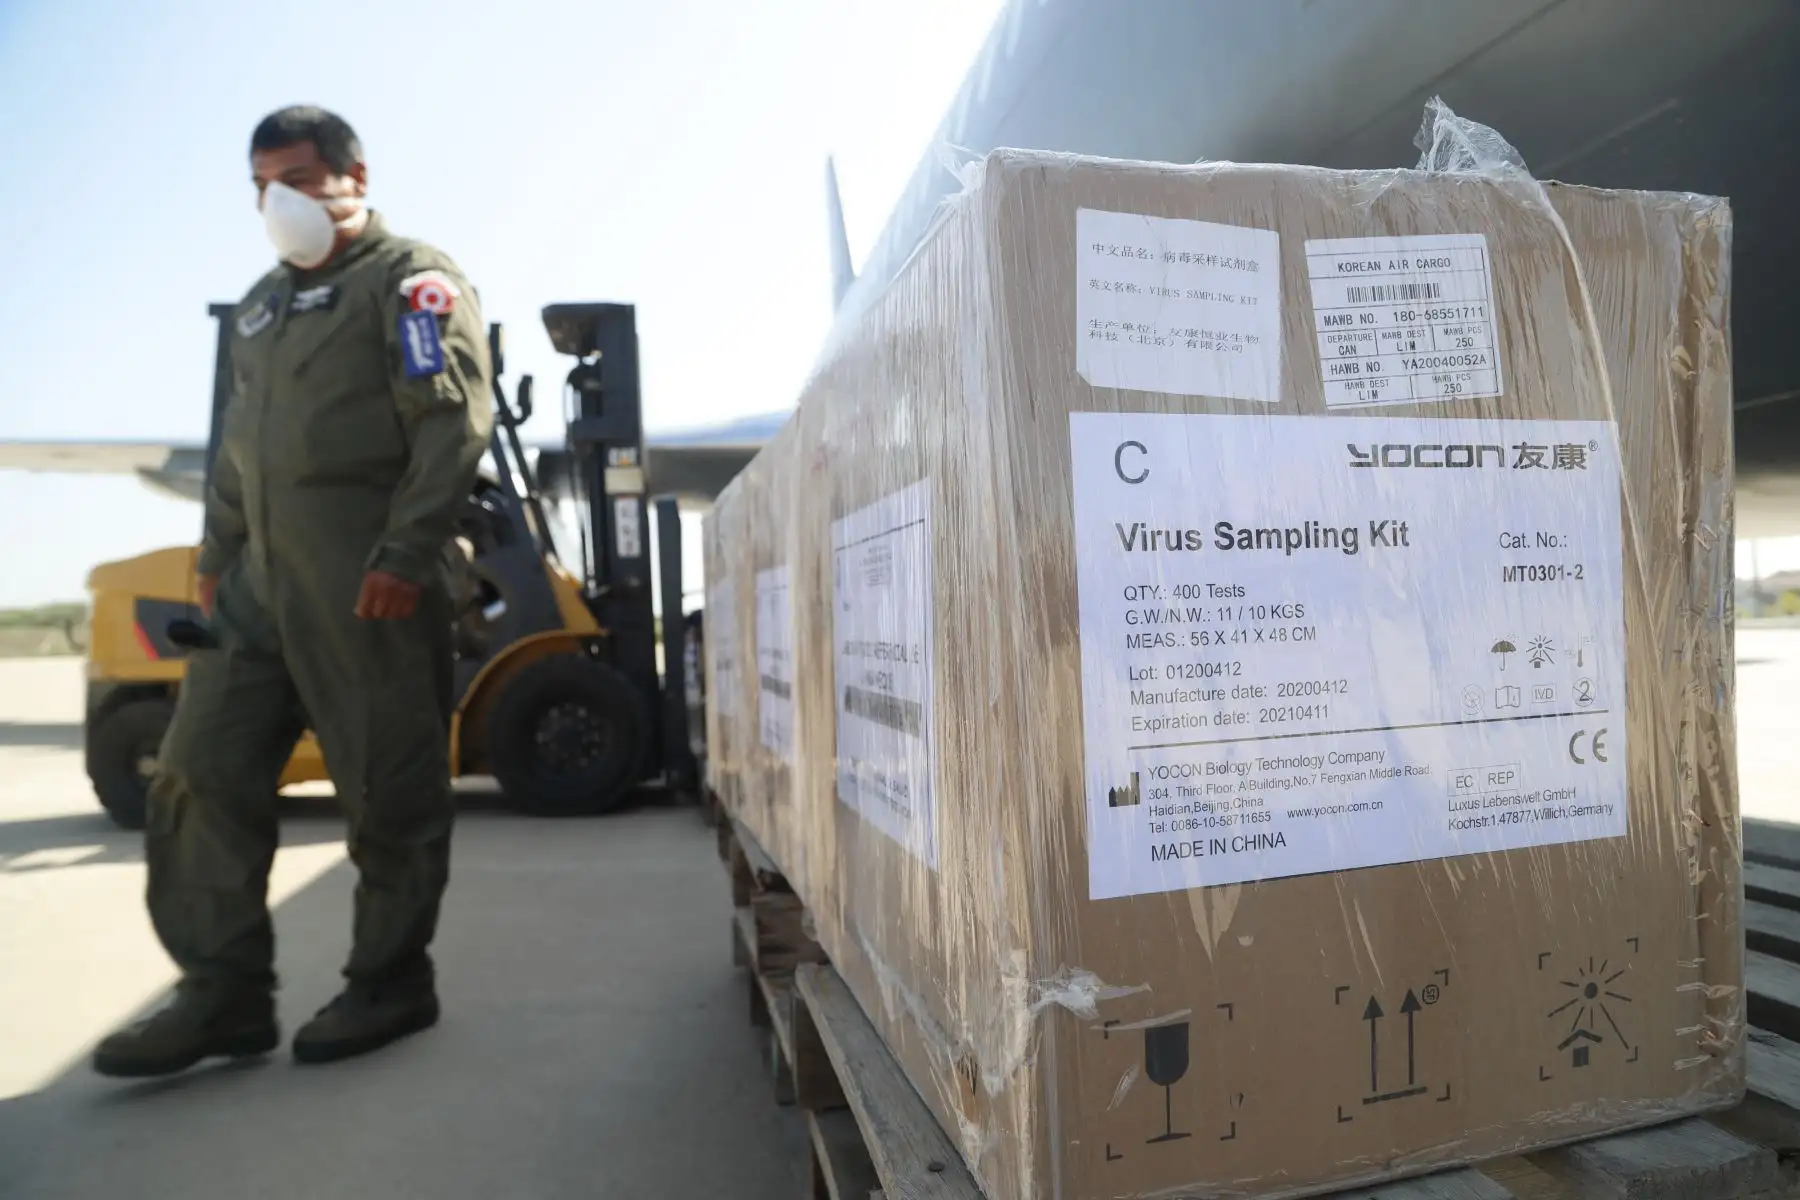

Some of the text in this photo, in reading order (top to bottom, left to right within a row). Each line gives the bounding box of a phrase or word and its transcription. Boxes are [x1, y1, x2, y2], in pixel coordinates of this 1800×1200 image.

[1337, 257, 1451, 273] KOREAN AIR CARGO
[1150, 285, 1180, 298] VIRUS
[1186, 289, 1235, 303] SAMPLING
[1240, 296, 1258, 305] KIT
[1323, 306, 1485, 327] MAWB NO. 180-68551711
[1327, 332, 1373, 344] DEPARTURE
[1382, 329, 1426, 340] MAWB DEST
[1443, 326, 1483, 336] MAWB PCS
[1338, 345, 1357, 356] CAN
[1396, 341, 1416, 351] LIM
[1455, 337, 1474, 348] 250
[1331, 362, 1360, 375] HAWB
[1402, 354, 1487, 370] YA20040052A
[1344, 379, 1389, 390] HAWB DEST
[1455, 373, 1471, 382] PCS
[1359, 390, 1379, 400] LIM
[1444, 383, 1462, 394] 250
[1114, 440, 1149, 484] C
[1115, 519, 1410, 556] Virus Sampling Kit
[1499, 531, 1567, 549] Cat. No.:
[1503, 564, 1584, 582] MT0301-2
[1123, 583, 1245, 602] QTY.: 400 Tests
[1125, 604, 1305, 625] G.W./N.W.: 11 / 10 KGS
[1126, 626, 1316, 649] MEAS.: 56 X 41 X 48 CM
[1129, 661, 1242, 681] Lot: 01200412
[1130, 679, 1348, 706] Manufacture date: 20200412
[1534, 688, 1554, 700] IVD
[1579, 680, 1590, 702] 2
[1132, 705, 1329, 733] Expiration date: 20210411
[1569, 728, 1608, 765] CE
[1148, 750, 1386, 781] YOCON Biology Technology Company
[1148, 787, 1172, 800] 304,
[1176, 785, 1203, 797] Third
[1238, 781, 1247, 792] A
[1321, 772, 1367, 785] Fengxian
[1369, 766, 1402, 780] Middle
[1455, 771, 1514, 789] EC REP
[1149, 797, 1264, 817] Haidian,Beijing,China
[1448, 787, 1576, 811] Luxus Lebenswelt GmbH
[1149, 800, 1383, 834] Tel: 0086-10-58711655 www.yocon.com.cn
[1151, 831, 1287, 862] MADE IN CHINA
